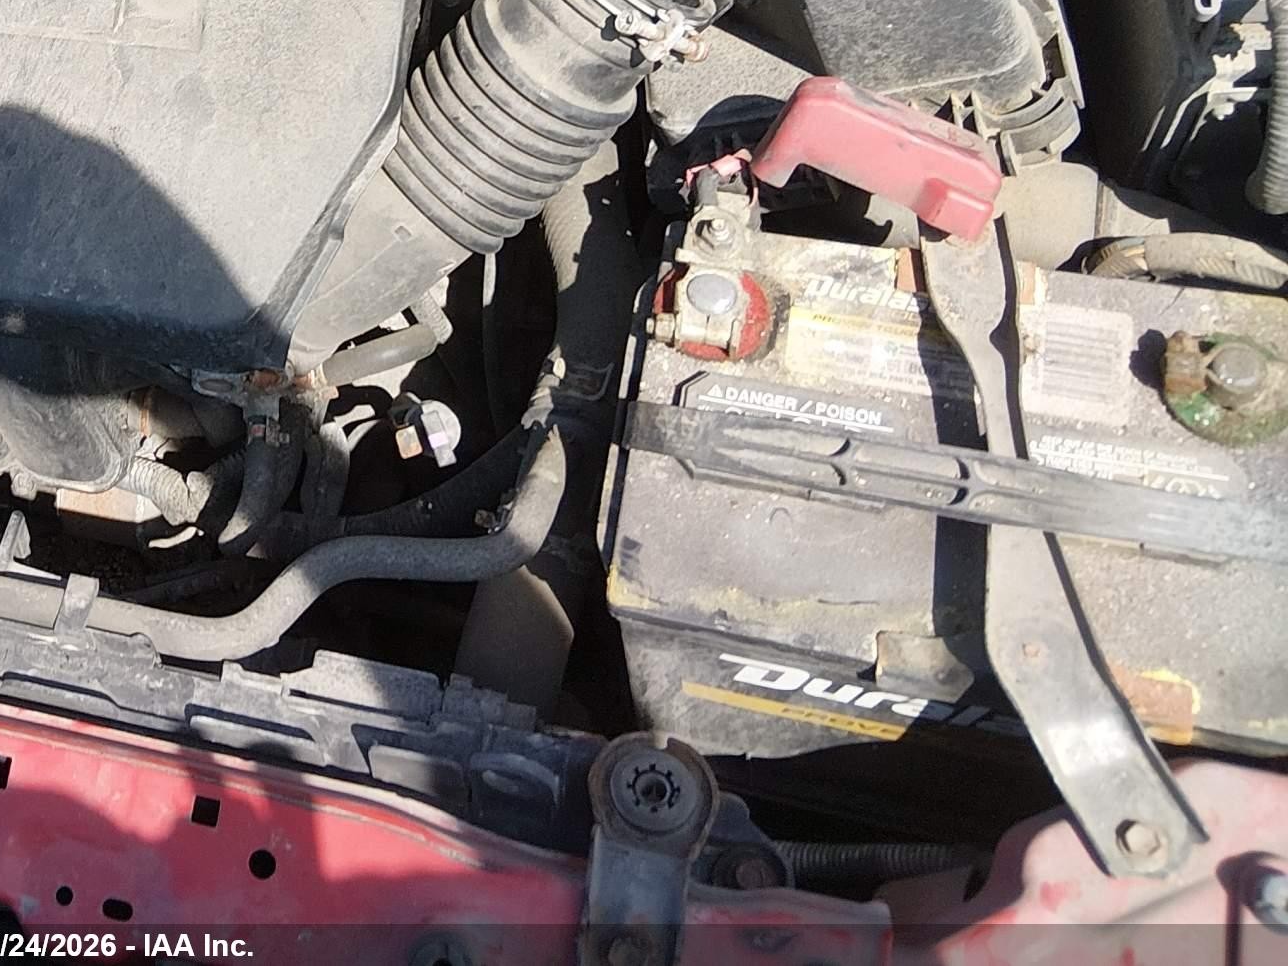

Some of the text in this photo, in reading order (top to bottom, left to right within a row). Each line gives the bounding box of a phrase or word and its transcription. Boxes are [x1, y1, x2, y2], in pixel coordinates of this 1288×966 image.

[725, 387, 798, 411] DANGER
[800, 401, 813, 413] /
[815, 402, 883, 426] POISON
